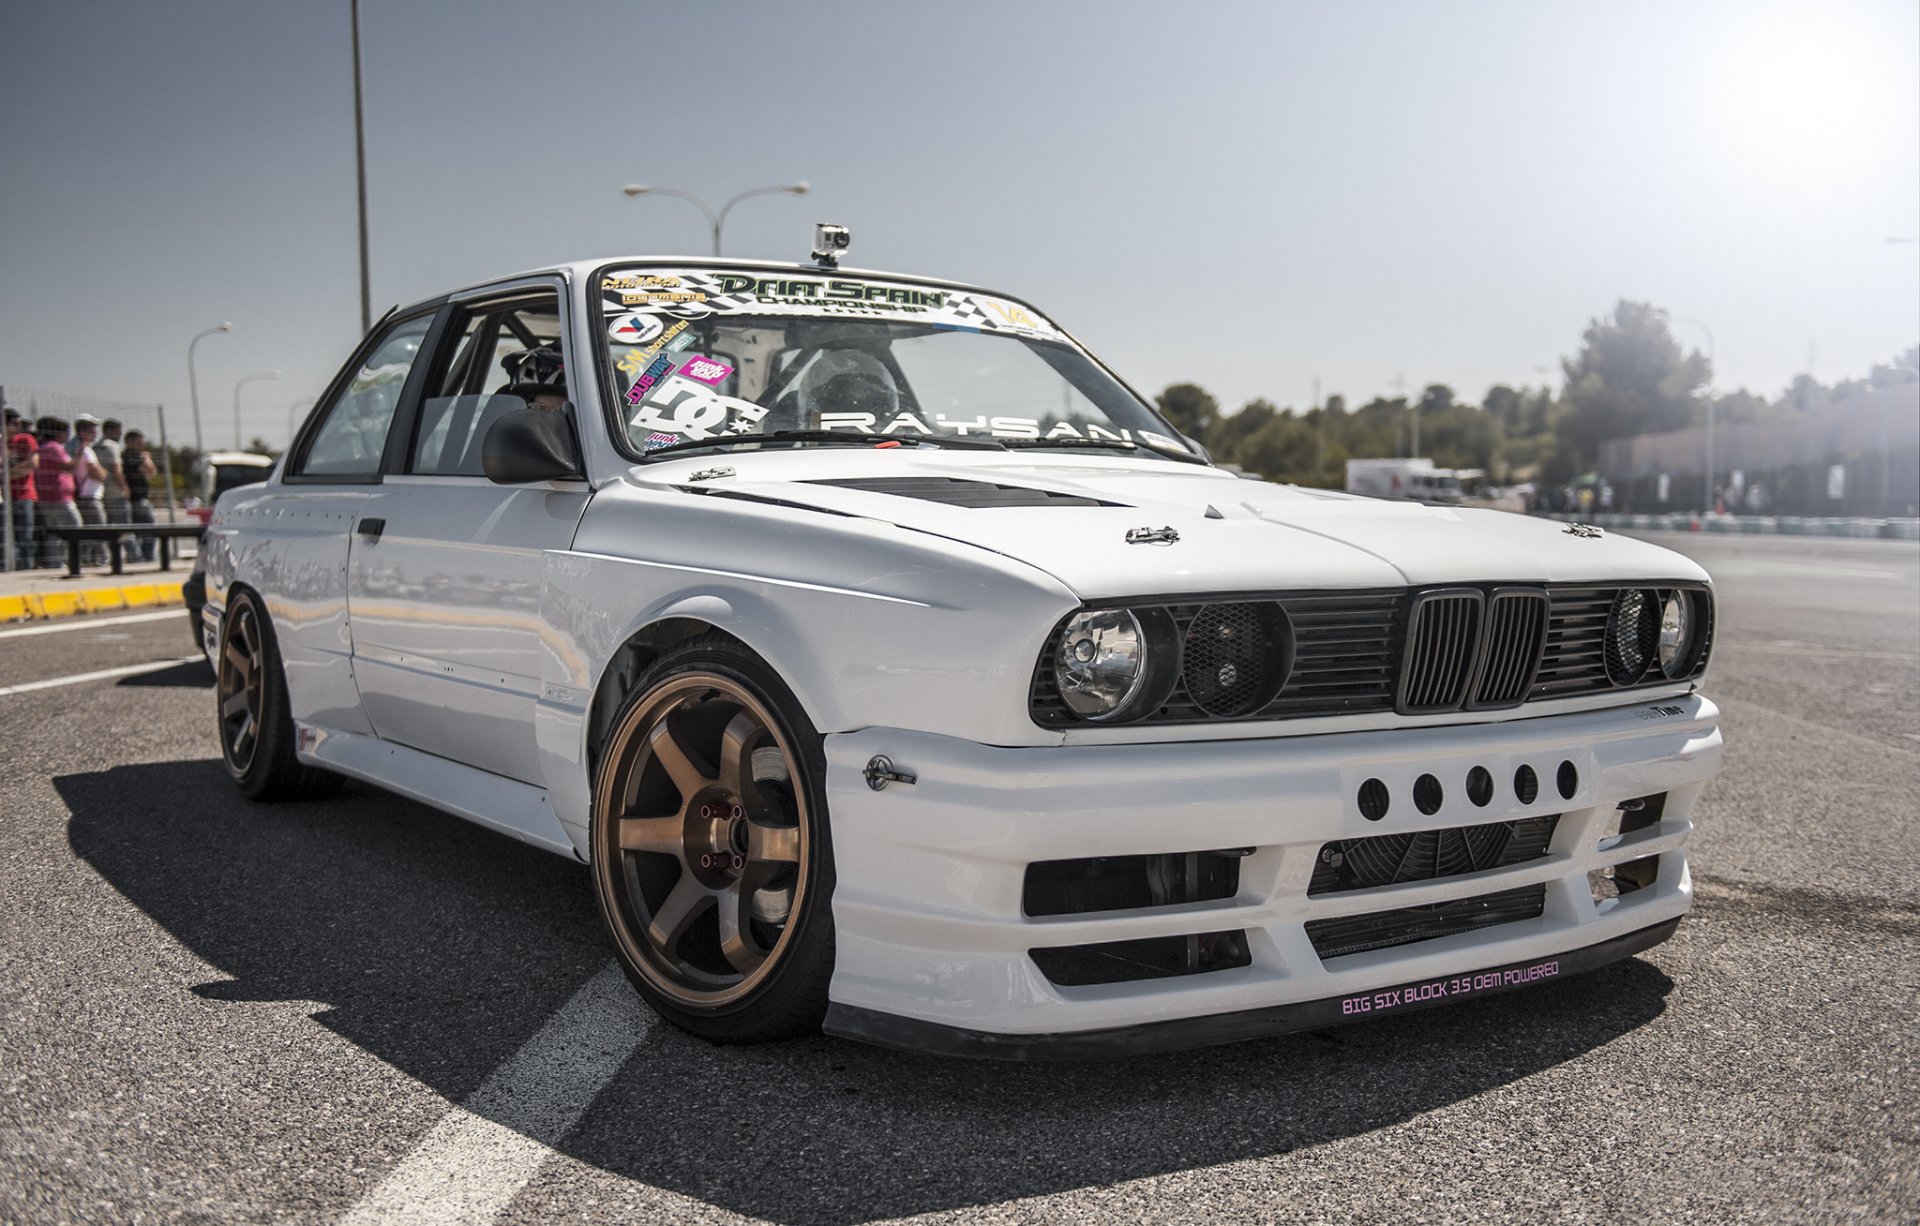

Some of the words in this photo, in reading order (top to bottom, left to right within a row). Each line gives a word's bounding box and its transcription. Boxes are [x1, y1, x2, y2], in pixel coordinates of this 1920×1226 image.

[755, 295, 928, 313] CHAMPIONSHIP
[986, 301, 1038, 328] 14
[820, 412, 1136, 449] RAYSAN
[1342, 997, 1372, 1015] BIG
[1374, 990, 1401, 1010] SIX
[1404, 981, 1448, 1004] BLOCK
[1450, 977, 1471, 994] 3.5
[1474, 972, 1502, 990] OEM
[1504, 960, 1559, 986] POWERED
